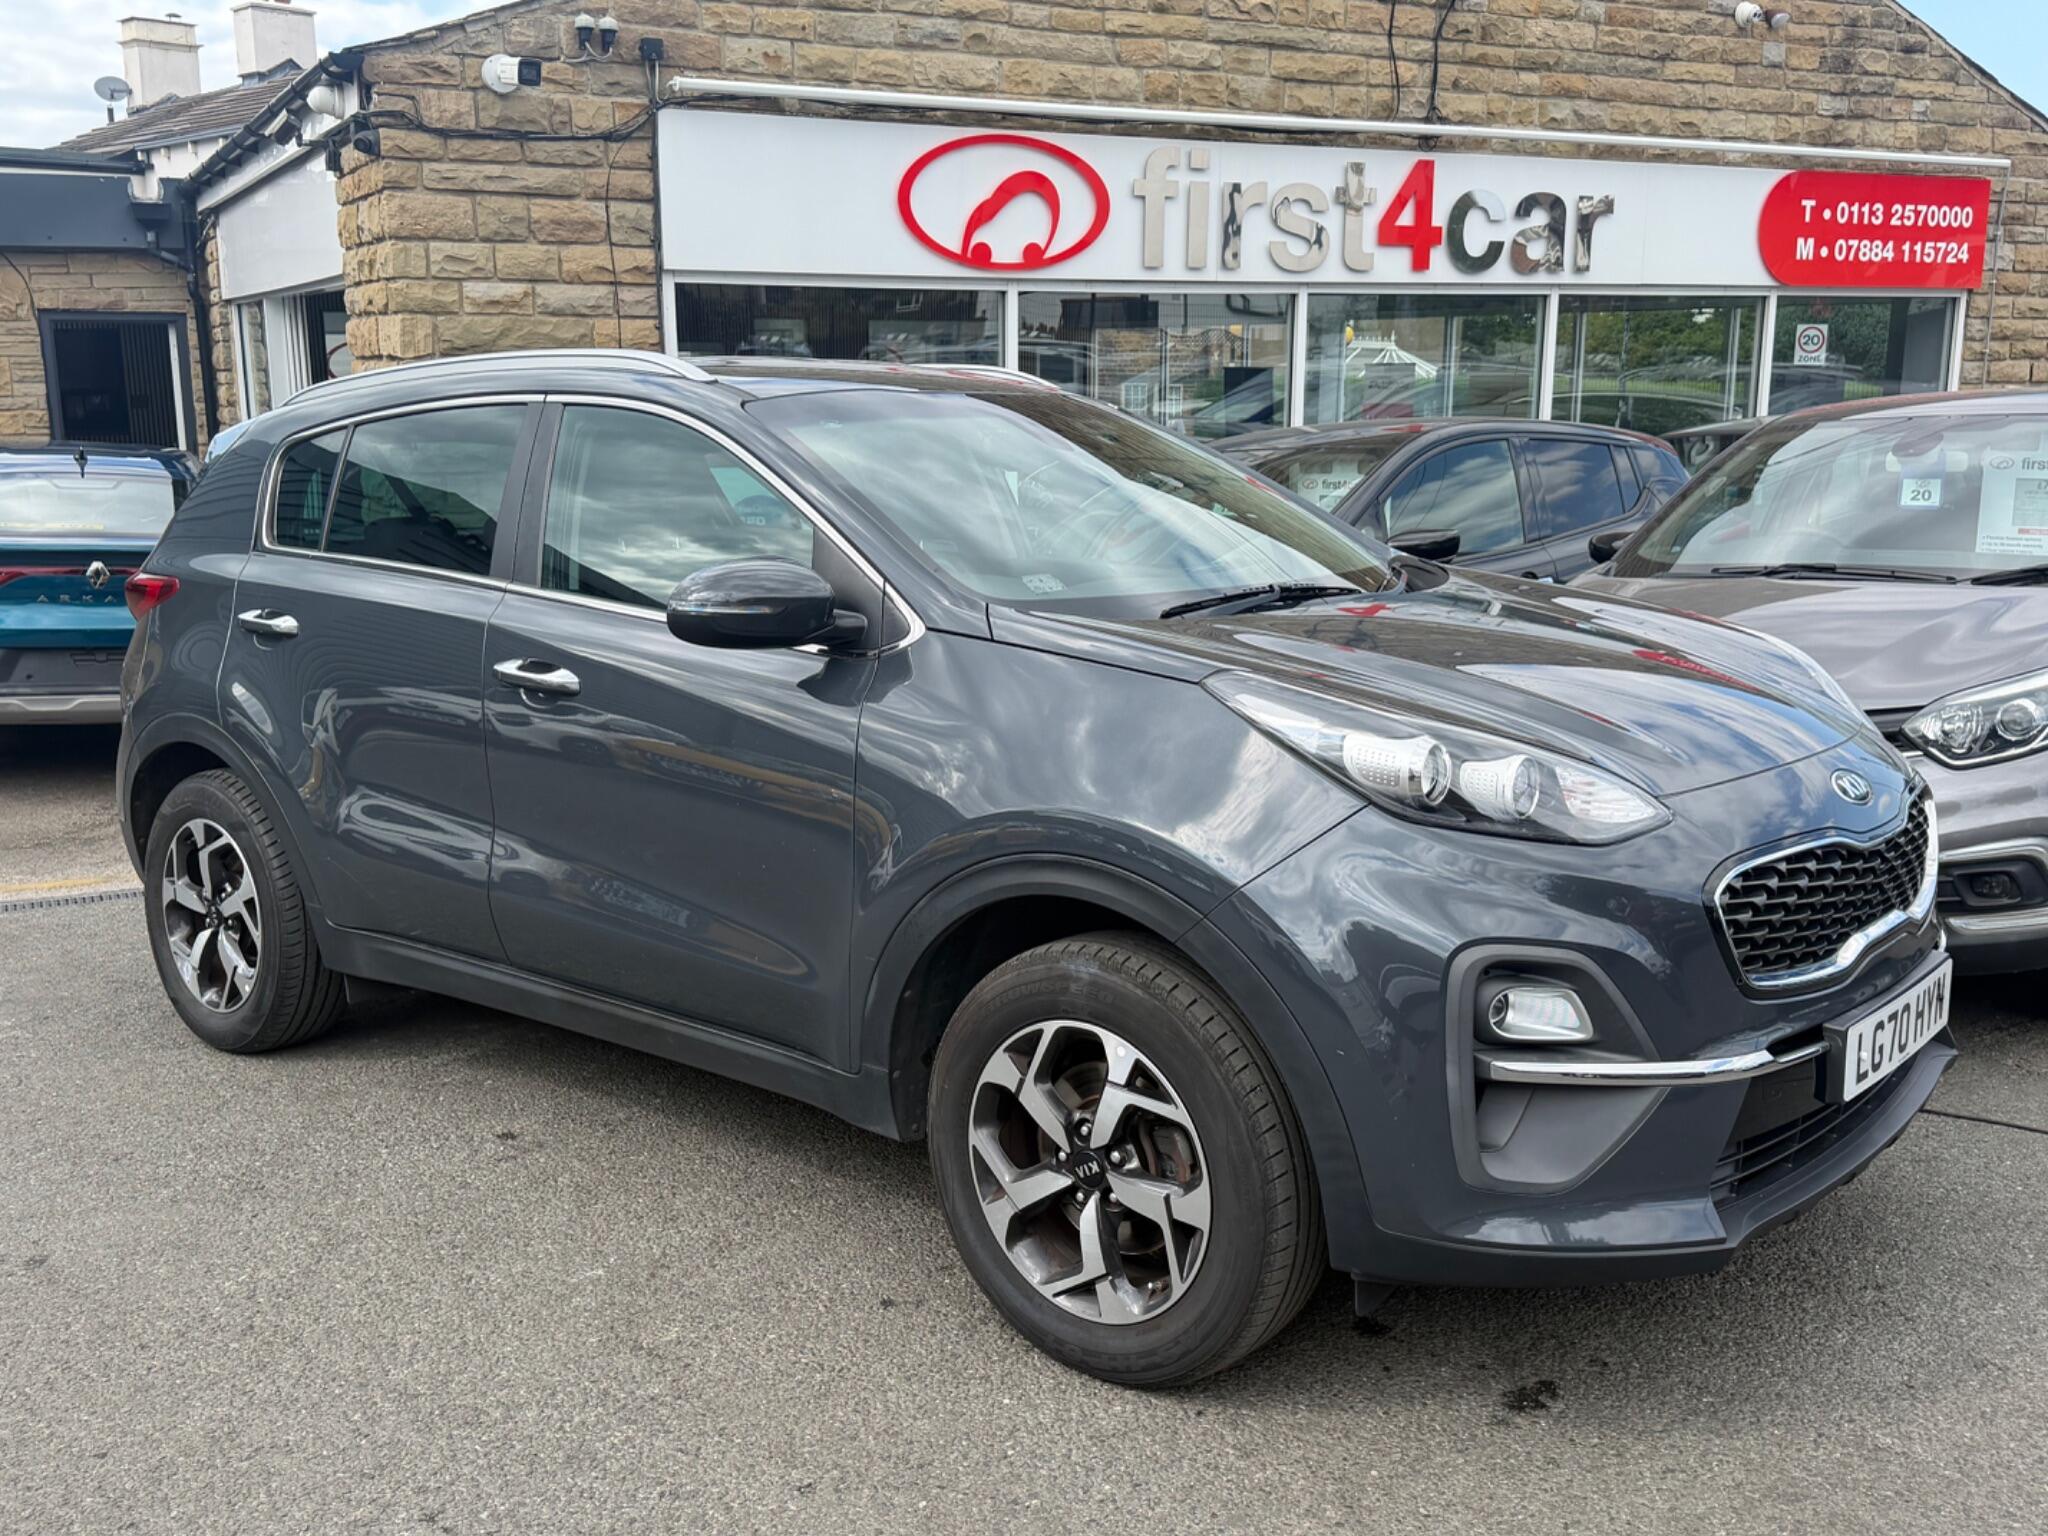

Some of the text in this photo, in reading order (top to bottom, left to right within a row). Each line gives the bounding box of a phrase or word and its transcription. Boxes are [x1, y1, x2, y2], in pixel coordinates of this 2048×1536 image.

[1132, 146, 1616, 275] first4car
[1801, 199, 1973, 228] T 0113 2570000
[1796, 237, 1969, 264] M 07884 115724
[1802, 334, 1820, 346] 20
[1910, 489, 1932, 502] 20
[1856, 972, 1946, 1086] LG70 HYN
[1075, 1160, 1100, 1179] KIA
